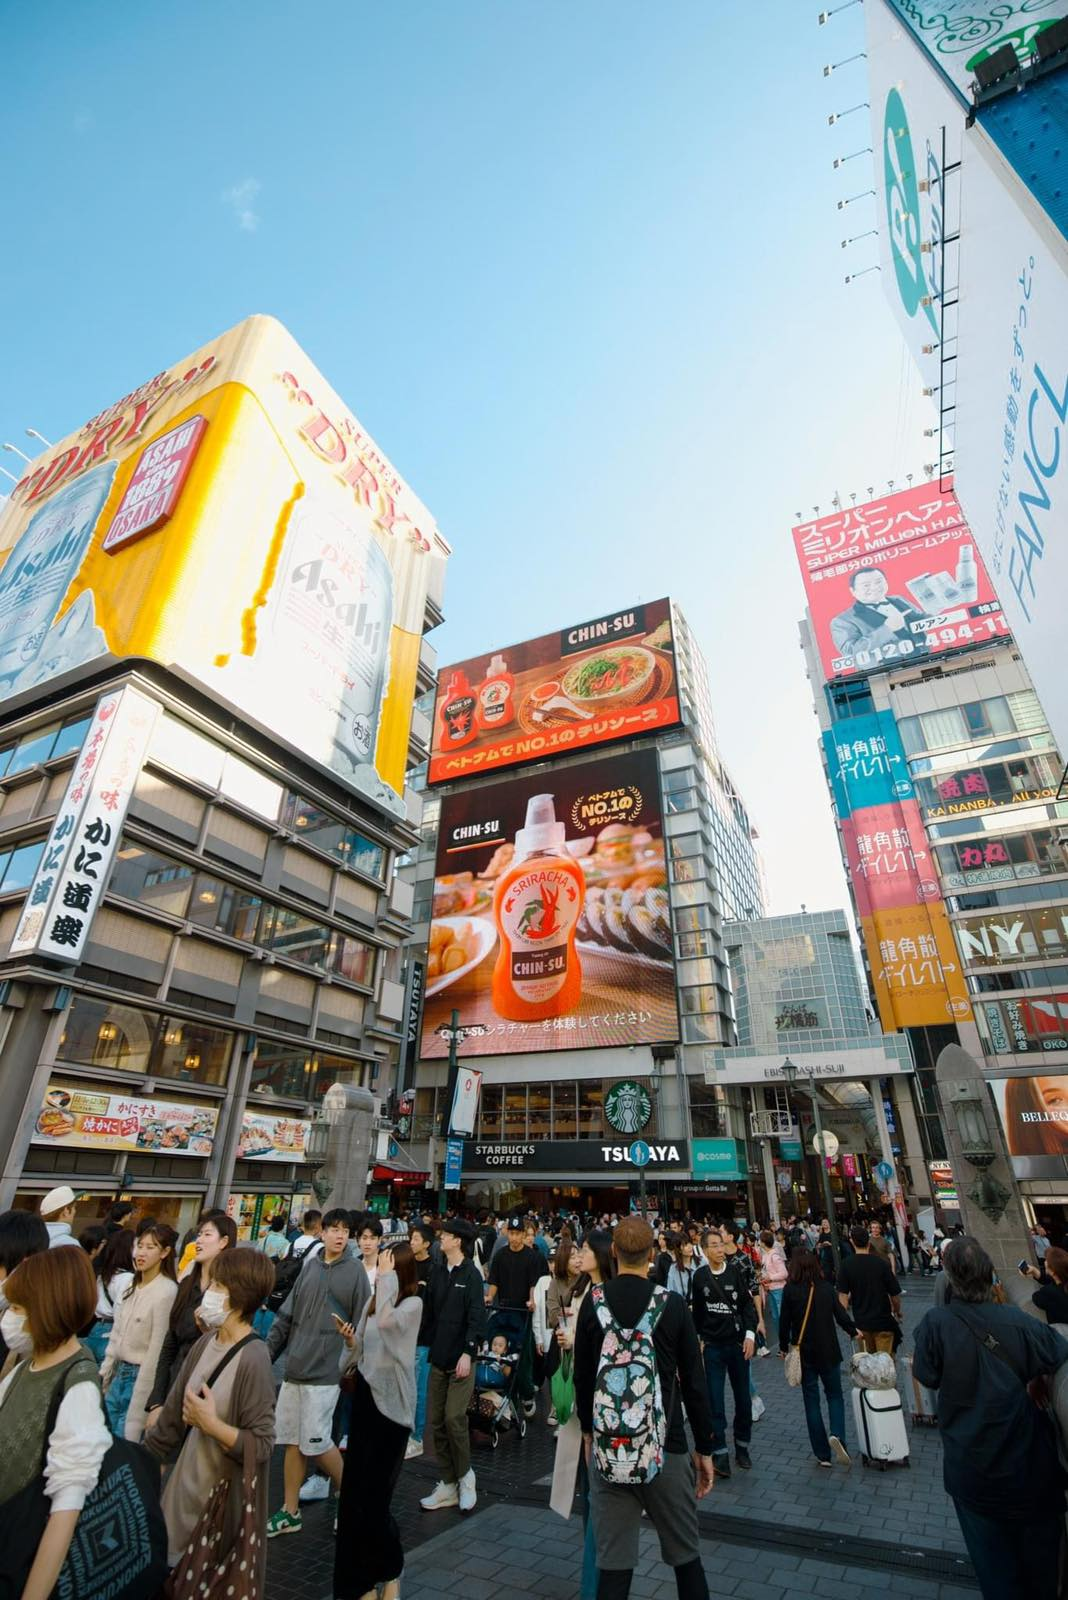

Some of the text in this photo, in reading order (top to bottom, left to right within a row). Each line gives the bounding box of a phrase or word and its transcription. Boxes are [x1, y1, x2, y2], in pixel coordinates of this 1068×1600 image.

[1009, 362, 1068, 624] FANCL
[799, 505, 888, 543] スーパー
[806, 545, 861, 570] SUPER
[865, 526, 929, 552] MILLION
[292, 559, 381, 655] Asahi
[567, 613, 636, 645] CHIN-SU
[913, 616, 949, 633] ルアン
[836, 735, 888, 762] 龍角散
[588, 787, 625, 801] ベトナムで
[948, 798, 997, 814] NANBA
[1012, 791, 1030, 803] All
[581, 796, 633, 818] NO.1の
[453, 819, 500, 841] CHIN-SU
[588, 812, 626, 827] チリソース
[855, 827, 910, 855] 龍角散
[512, 871, 569, 896] SRIRACHA
[880, 933, 940, 962] 龍角散
[958, 922, 1024, 960] NY
[513, 956, 565, 975] CHIN-SU
[407, 968, 422, 1043] TSUTAYA
[763, 1064, 845, 1079] EBISASHI-SUJI
[116, 1101, 157, 1118] かにすき
[82, 1116, 118, 1133] 焼かに
[475, 1145, 536, 1155] STARBUCKS
[485, 1155, 524, 1165] COFFEE
[601, 1145, 680, 1162] TSUAYA
[119, 1462, 152, 1554] KINOKUNIYA
